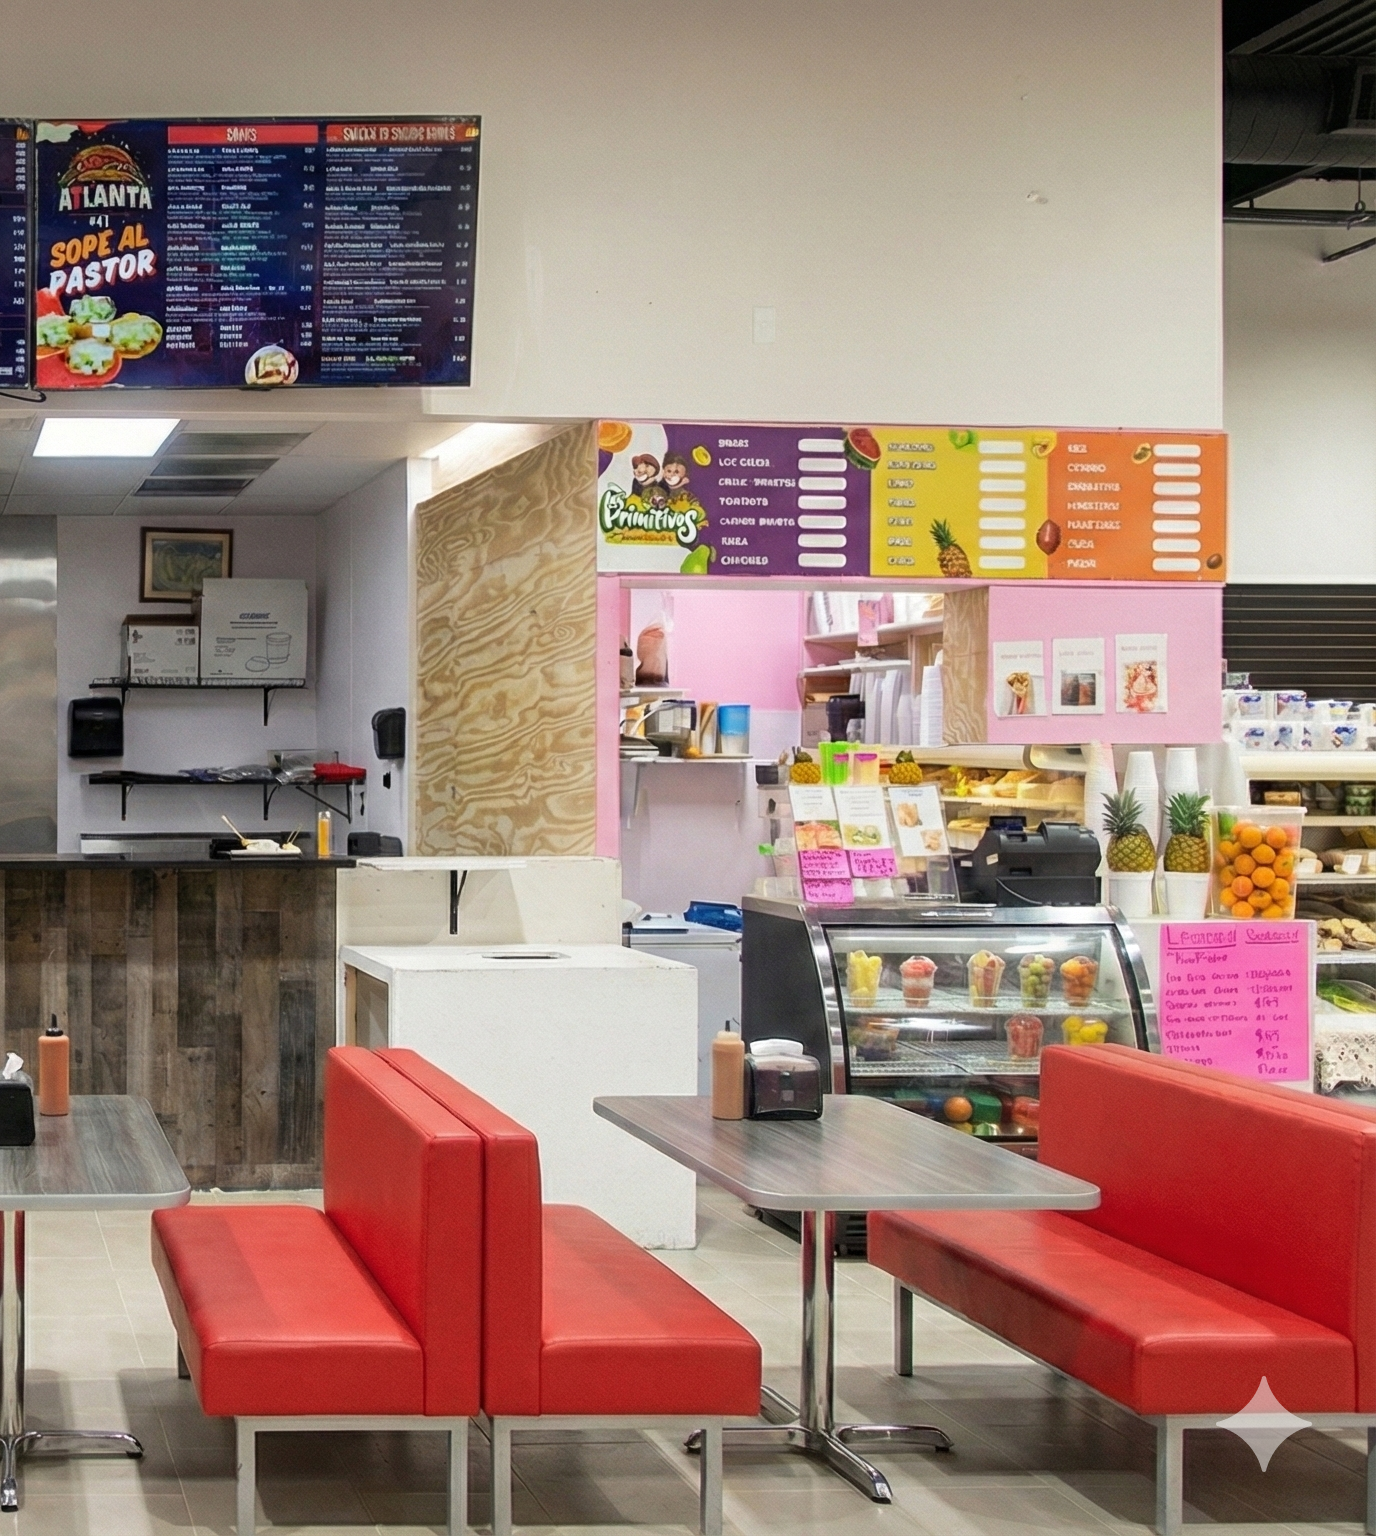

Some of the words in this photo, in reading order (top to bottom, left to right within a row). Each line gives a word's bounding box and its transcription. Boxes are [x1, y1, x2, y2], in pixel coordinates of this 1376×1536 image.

[58, 183, 153, 212] ATLANTA
[50, 229, 114, 268] SOPE
[117, 222, 150, 252] AL
[49, 249, 156, 296] PASTOR
